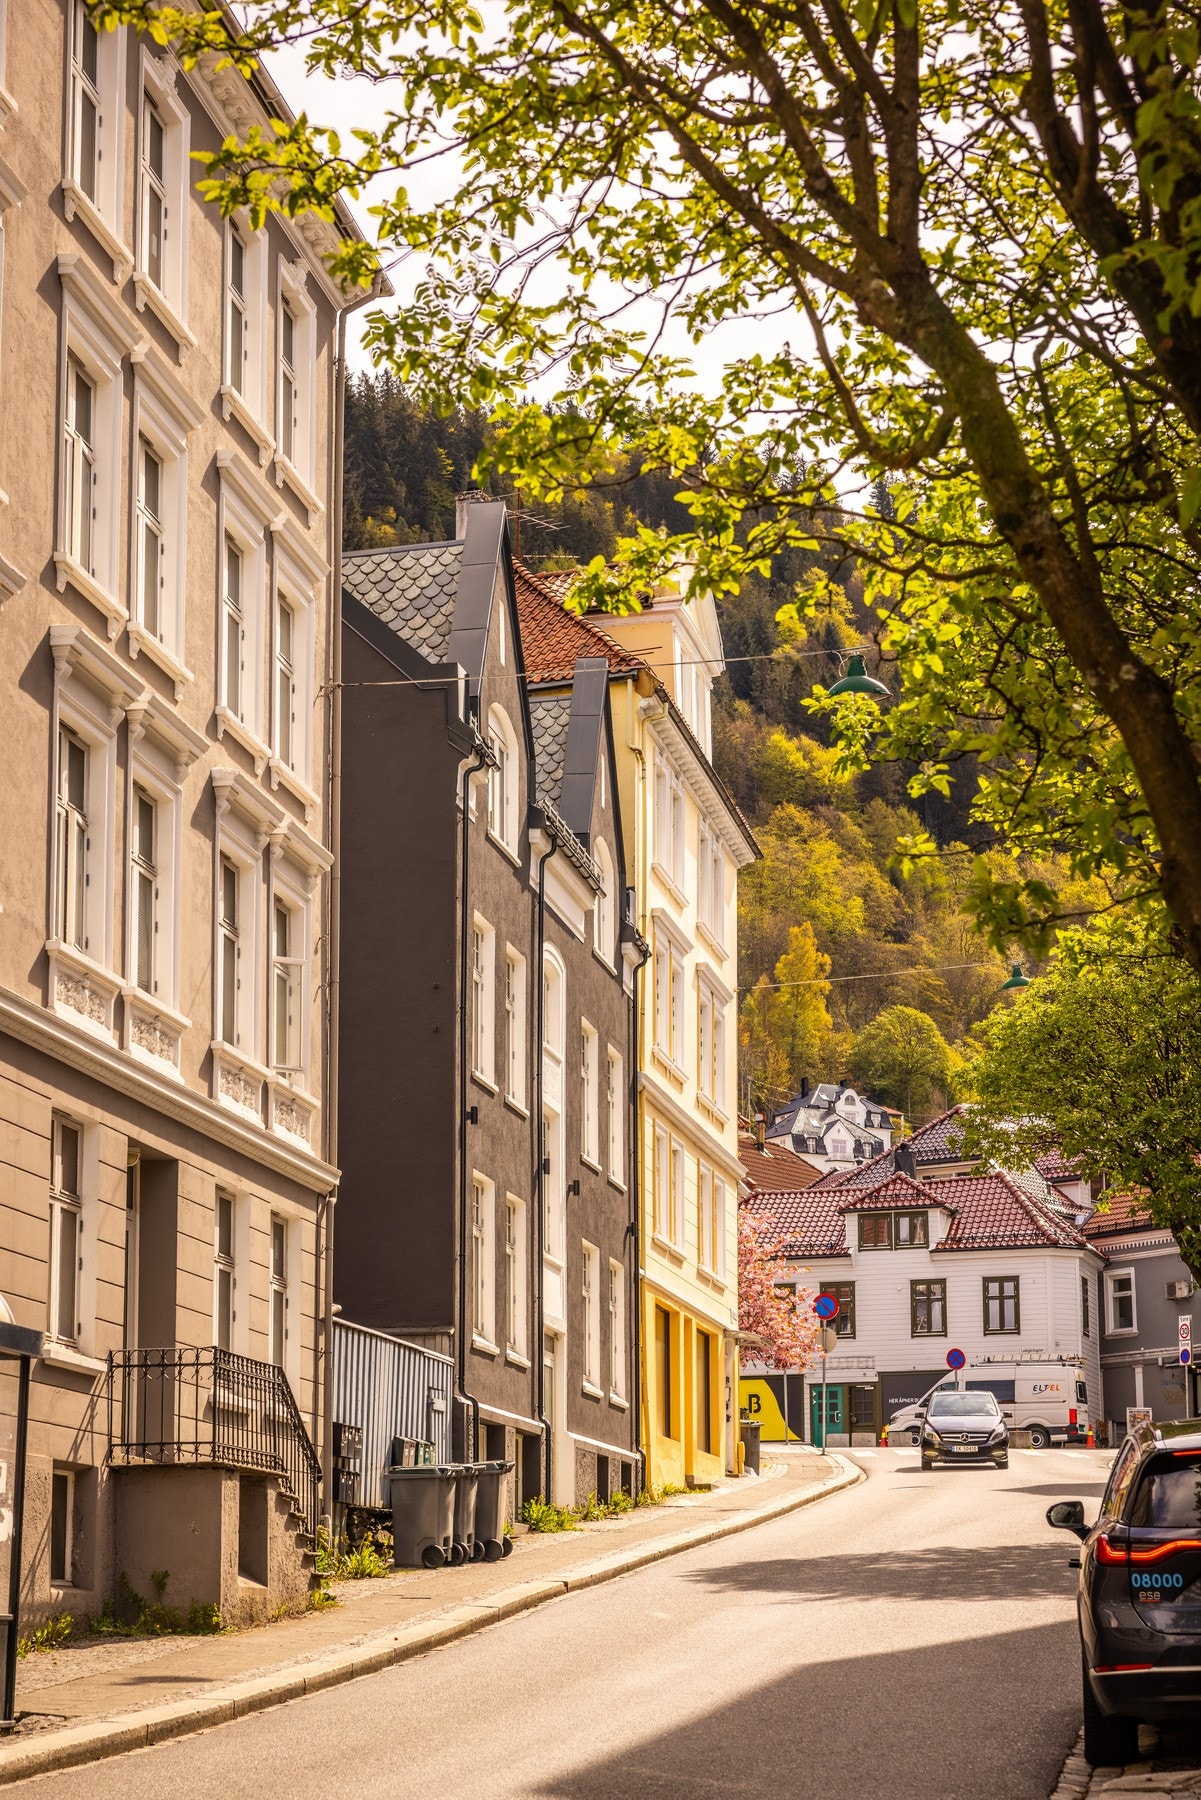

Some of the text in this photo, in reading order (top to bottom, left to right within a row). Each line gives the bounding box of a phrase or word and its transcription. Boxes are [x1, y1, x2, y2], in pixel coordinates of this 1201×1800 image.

[1181, 1327, 1188, 1335] 30
[1032, 1384, 1060, 1392] ELTEL
[1131, 1573, 1183, 1588] 08000
